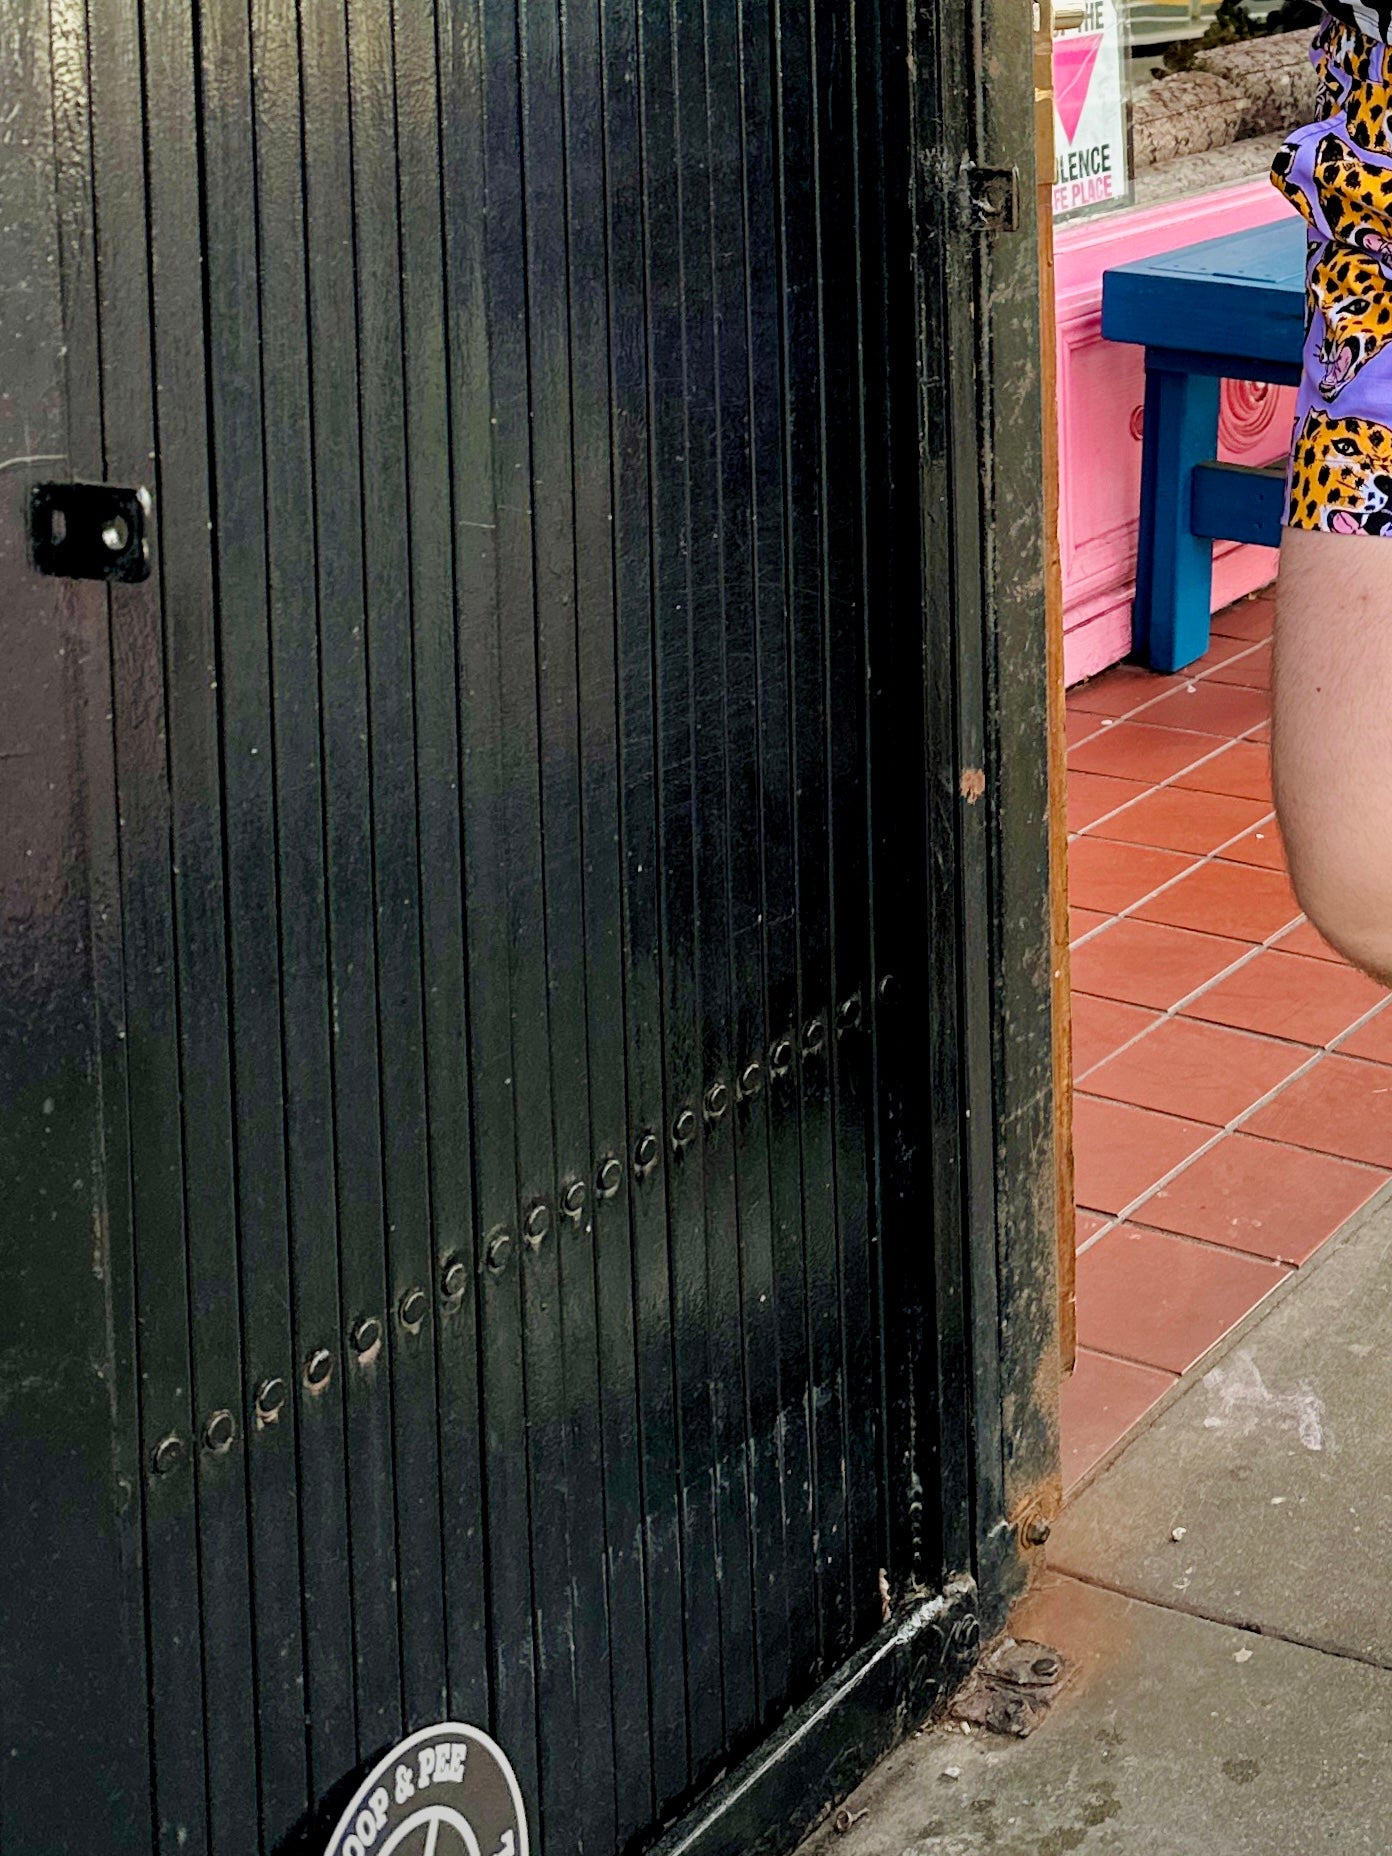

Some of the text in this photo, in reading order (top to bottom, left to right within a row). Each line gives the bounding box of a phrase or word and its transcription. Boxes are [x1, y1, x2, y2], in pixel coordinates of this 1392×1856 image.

[1071, 175, 1113, 207] PLACE
[395, 1764, 415, 1805] &
[418, 1743, 468, 1790] PEE
